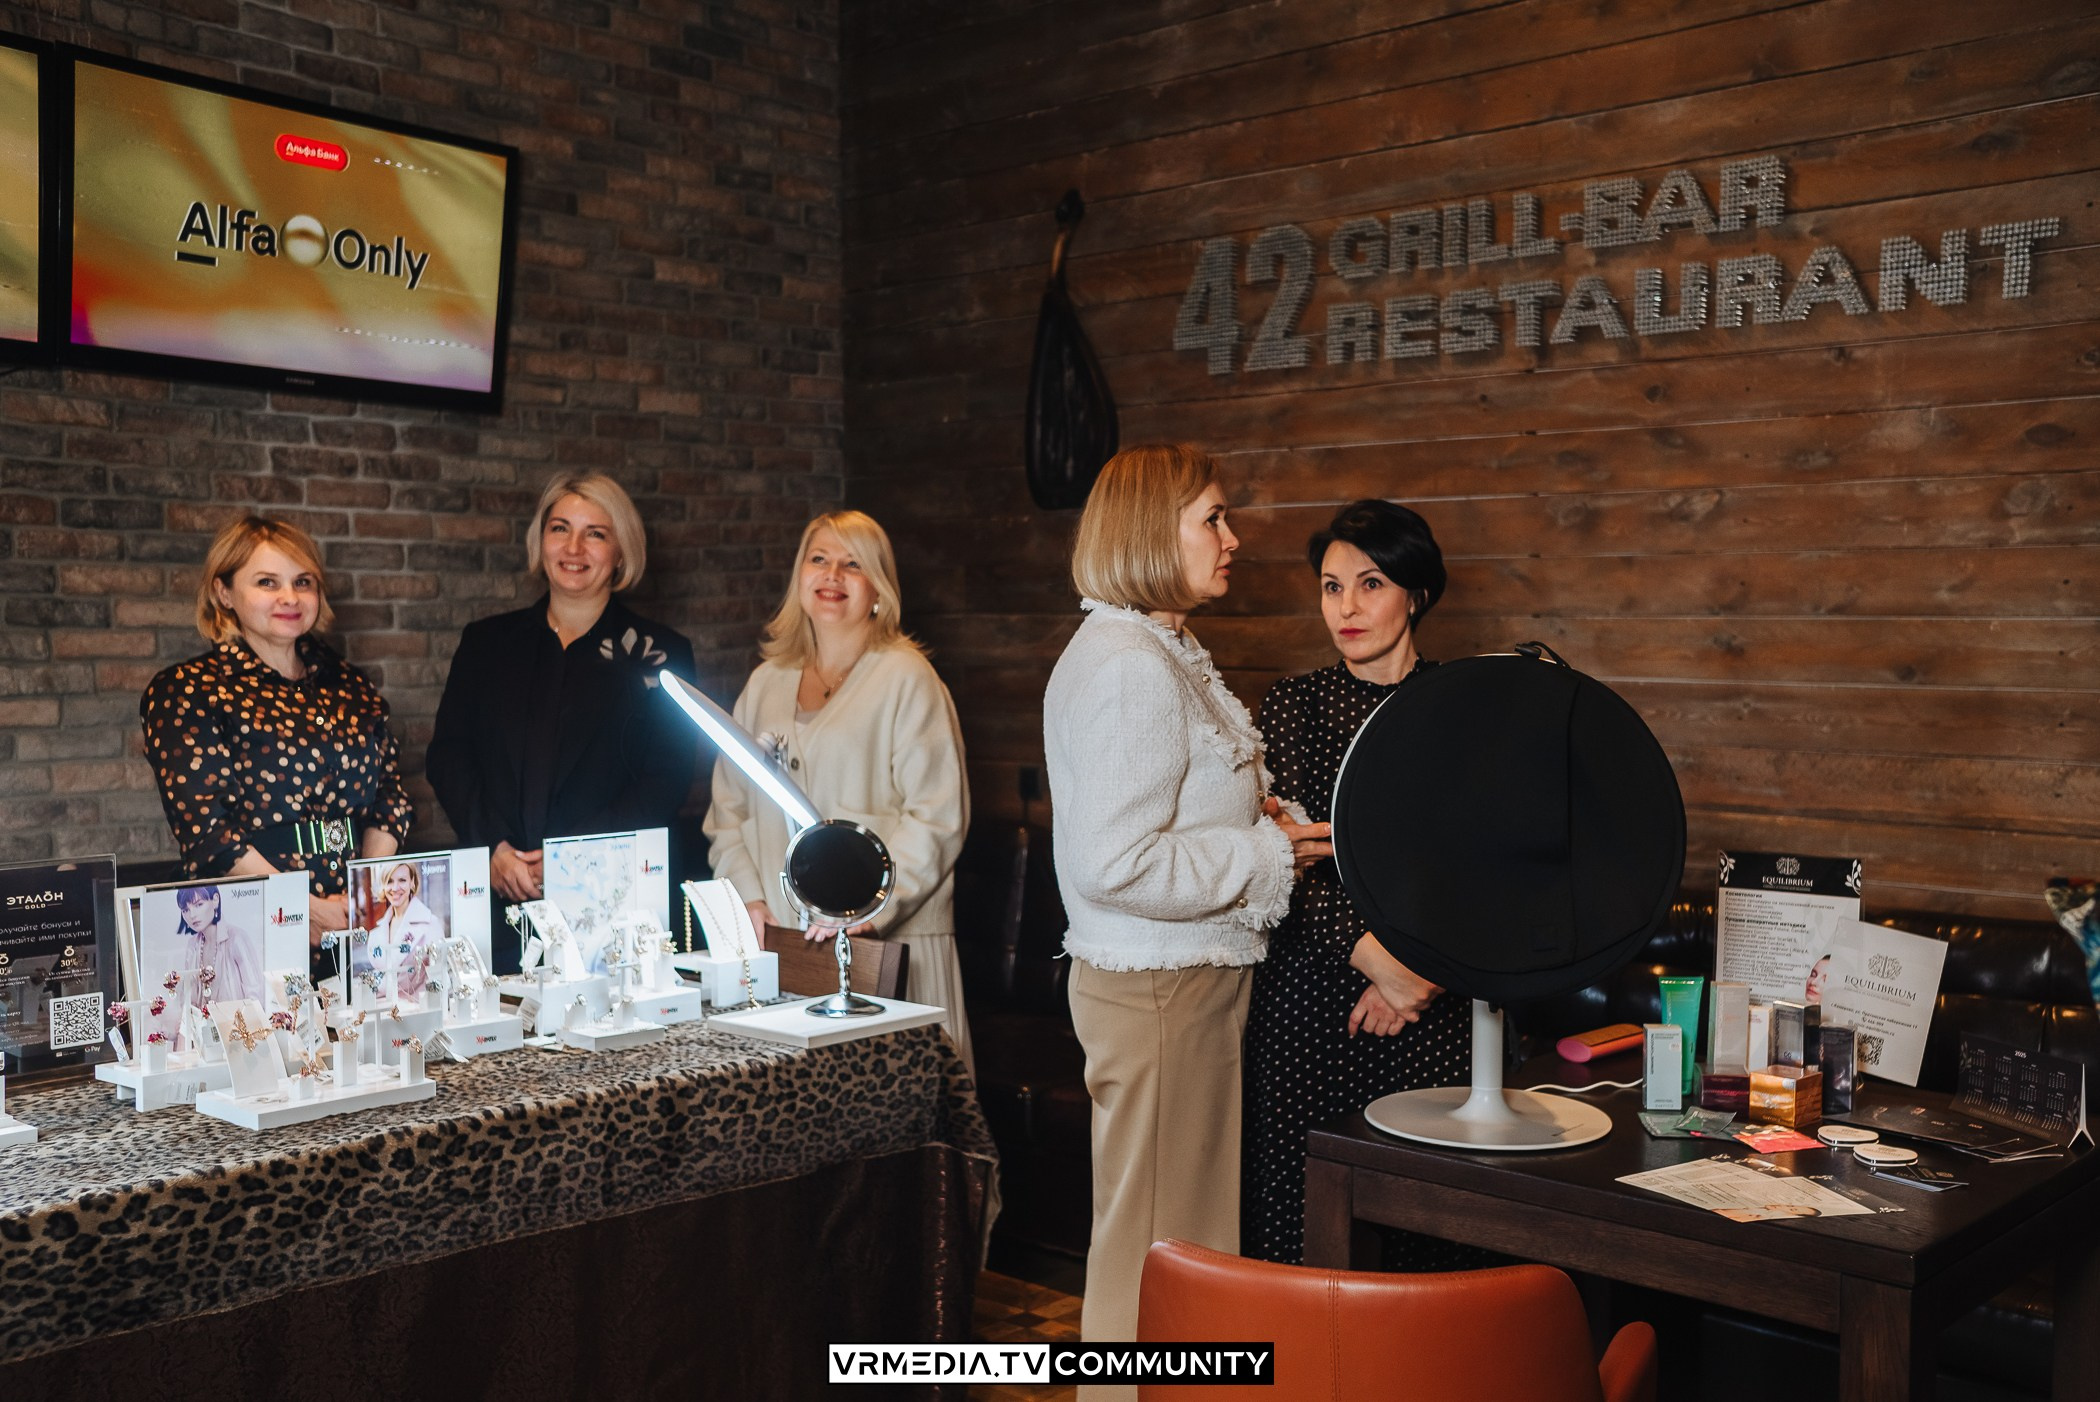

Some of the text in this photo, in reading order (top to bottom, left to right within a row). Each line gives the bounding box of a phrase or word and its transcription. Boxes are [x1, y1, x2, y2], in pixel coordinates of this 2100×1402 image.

[1328, 154, 1787, 280] GRILL-BAR
[175, 201, 430, 290] Alfa Only
[1172, 223, 1316, 377] 42
[1326, 216, 2061, 366] RESTAURANT
[1762, 876, 1814, 888] EQUILIBRIUM
[38, 934, 56, 942] ими
[58, 930, 92, 940] покупки
[41, 921, 72, 931] бонусы
[60, 958, 78, 968] 30%
[1844, 974, 1917, 1001] EQUILIBRIUM
